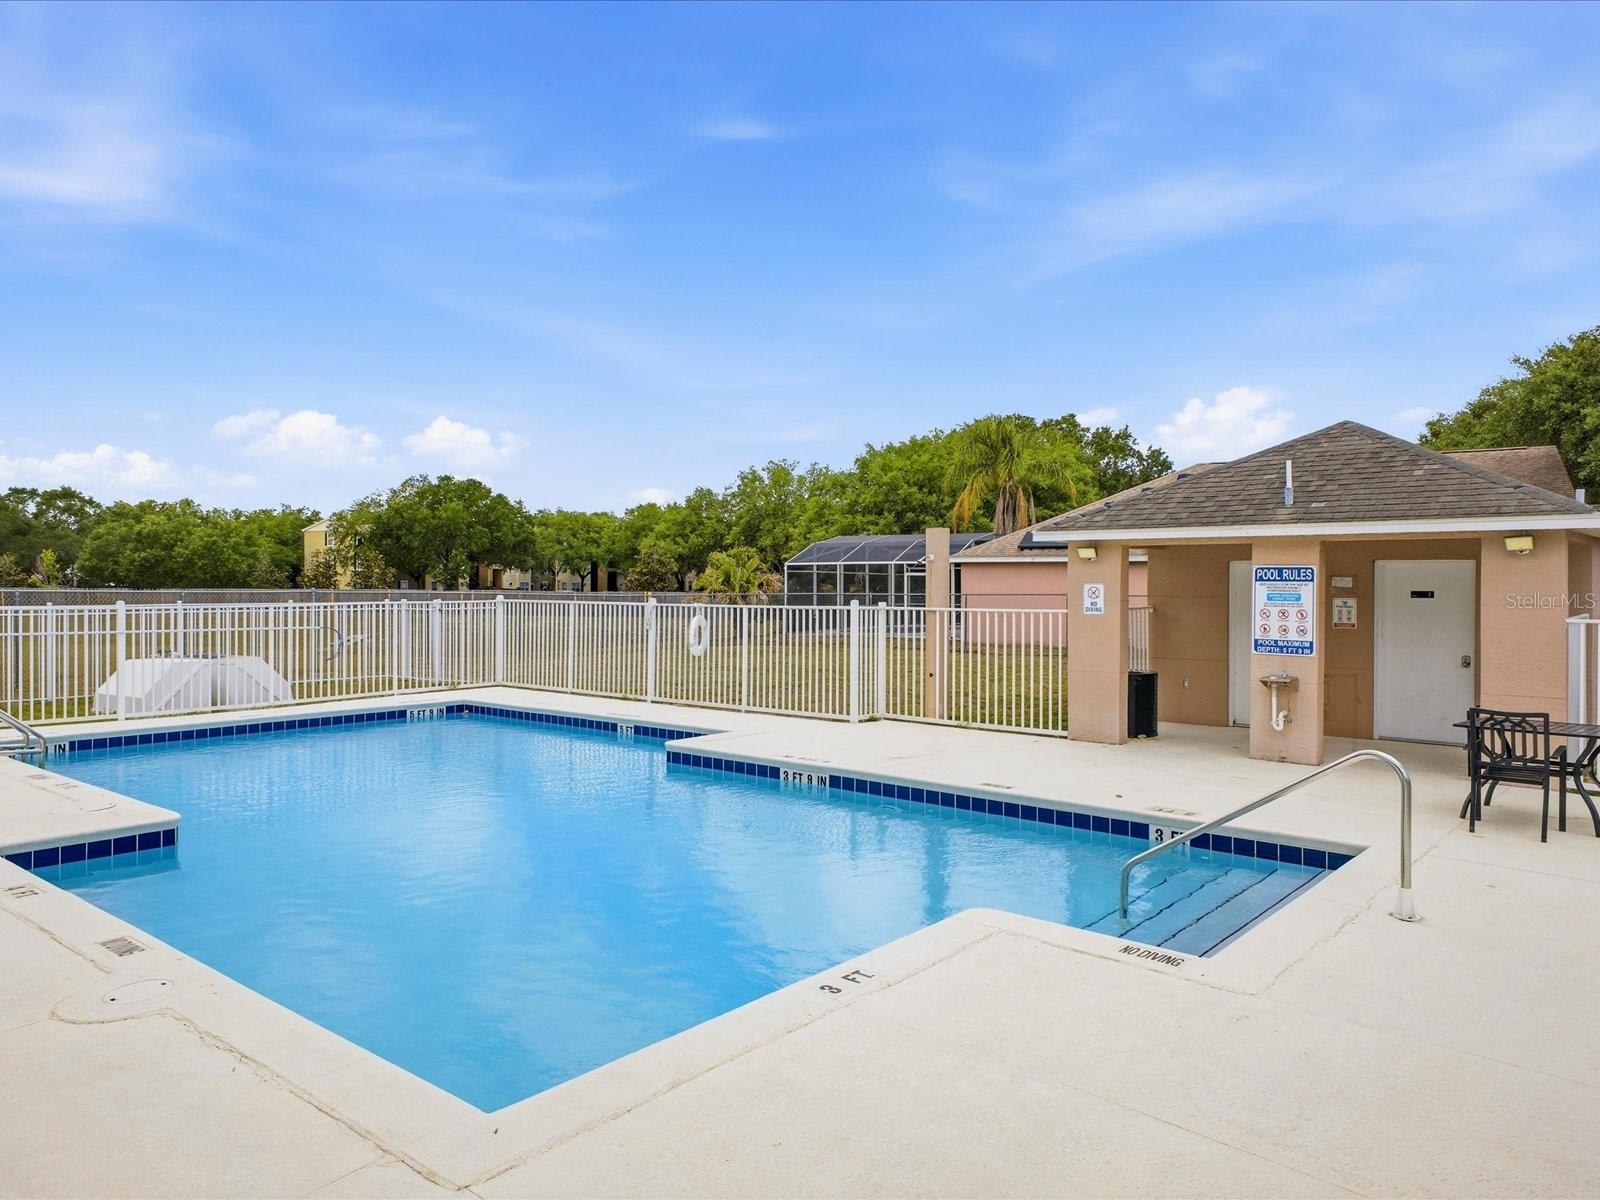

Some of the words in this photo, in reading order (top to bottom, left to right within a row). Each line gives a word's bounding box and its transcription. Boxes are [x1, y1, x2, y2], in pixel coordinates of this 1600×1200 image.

[1257, 568, 1281, 580] POOL
[1283, 568, 1312, 580] RULES
[1257, 639, 1277, 647] POOL
[1278, 640, 1310, 648] MAXIMUM
[54, 743, 67, 753] IN
[783, 770, 789, 782] 3
[792, 771, 804, 784] FT
[817, 775, 827, 787] IN
[1155, 828, 1164, 842] 3
[1118, 945, 1141, 956] NO
[1136, 949, 1185, 967] DIVING
[819, 984, 843, 994] 3
